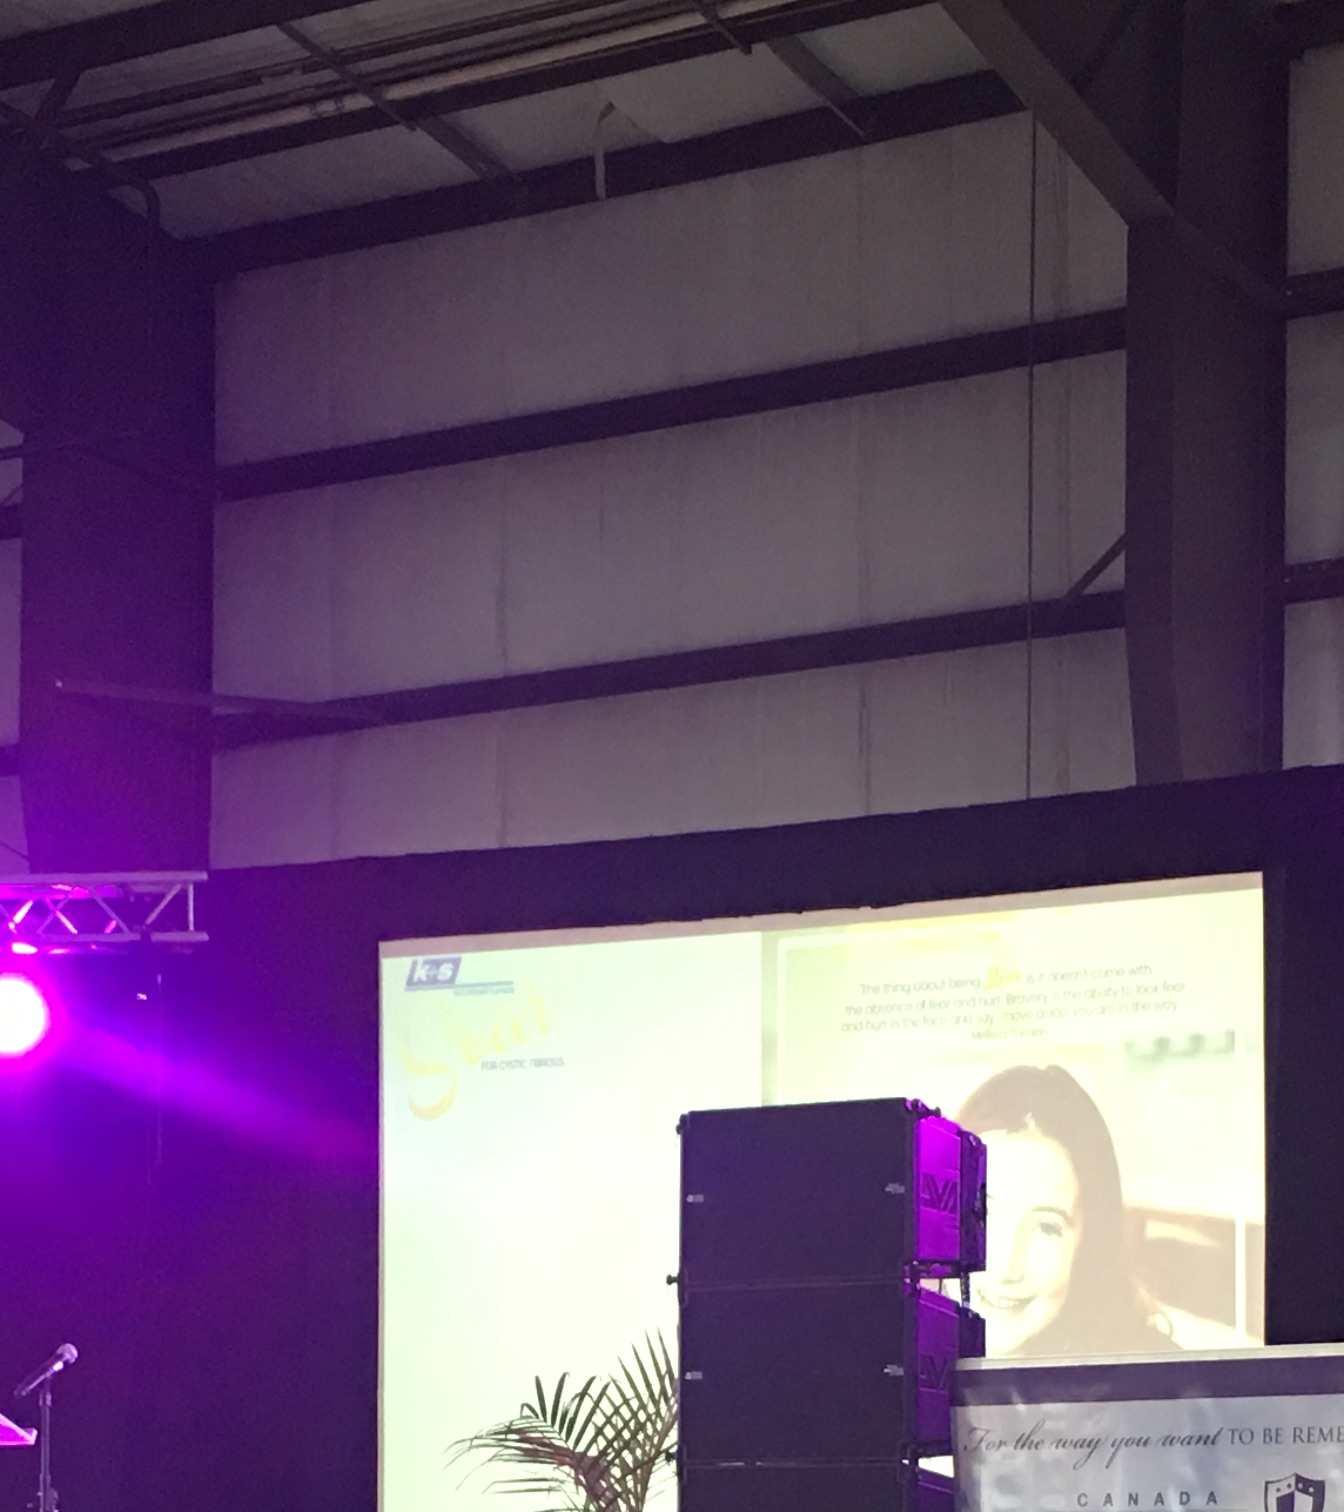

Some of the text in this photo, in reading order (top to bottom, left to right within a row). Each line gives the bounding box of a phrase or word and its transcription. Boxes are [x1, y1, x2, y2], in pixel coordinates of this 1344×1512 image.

[964, 1425, 1008, 1452] For
[1013, 1418, 1047, 1451] the
[1050, 1435, 1102, 1471] way
[1110, 1433, 1151, 1470] you
[1158, 1427, 1224, 1448] want
[1227, 1427, 1255, 1446] TO
[1262, 1426, 1284, 1445] BE
[1077, 1490, 1219, 1508] CANADA
